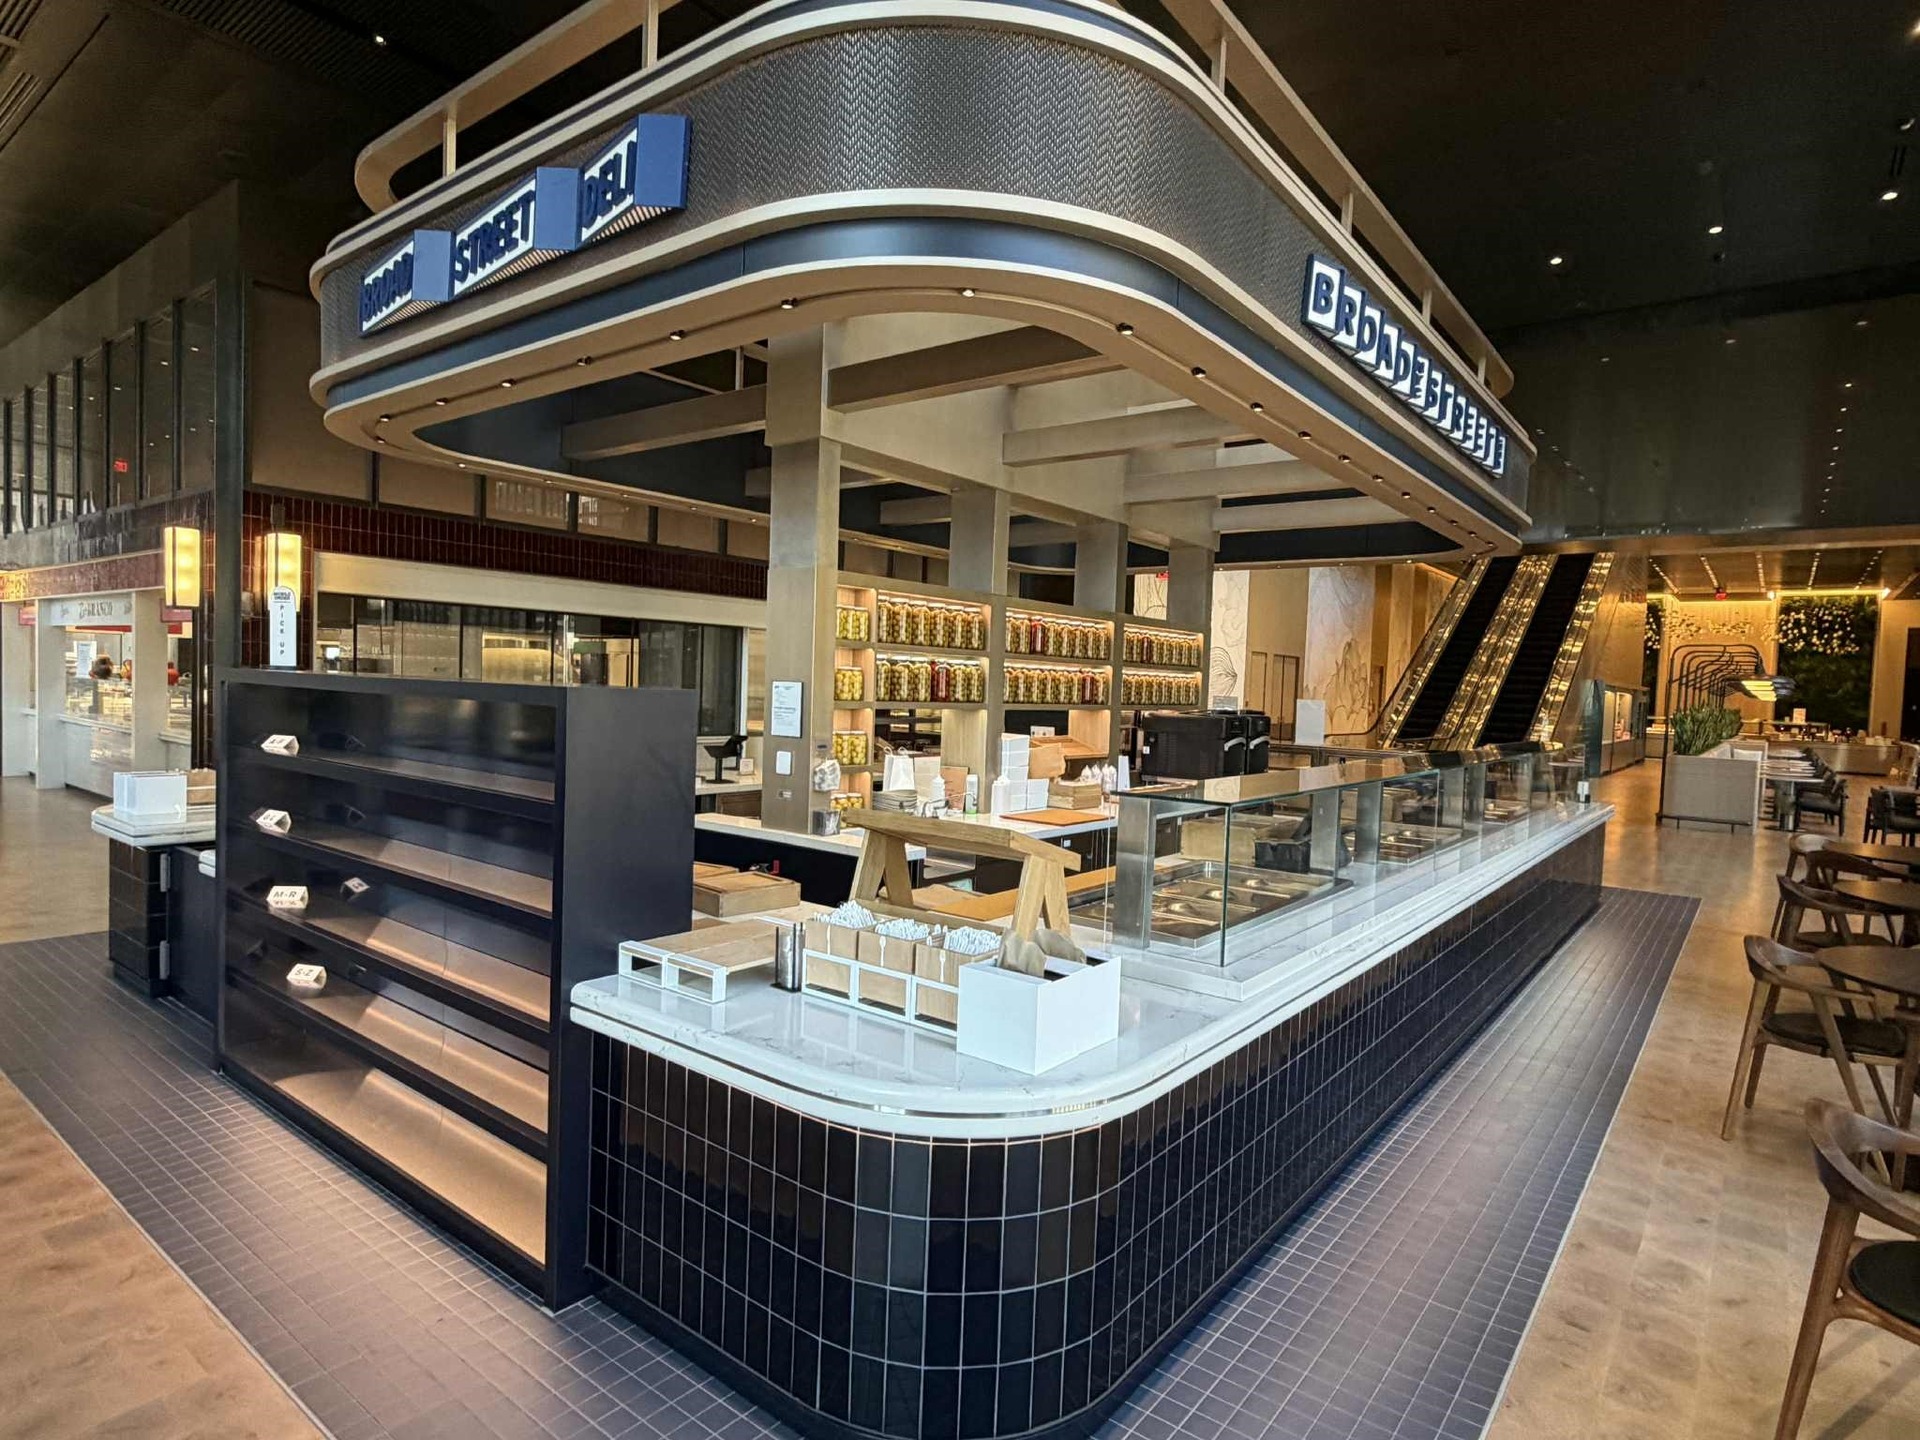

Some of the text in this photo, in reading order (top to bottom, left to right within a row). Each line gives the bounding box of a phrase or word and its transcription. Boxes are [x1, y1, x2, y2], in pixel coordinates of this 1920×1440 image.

[360, 139, 637, 323] BROAD STREET DELI
